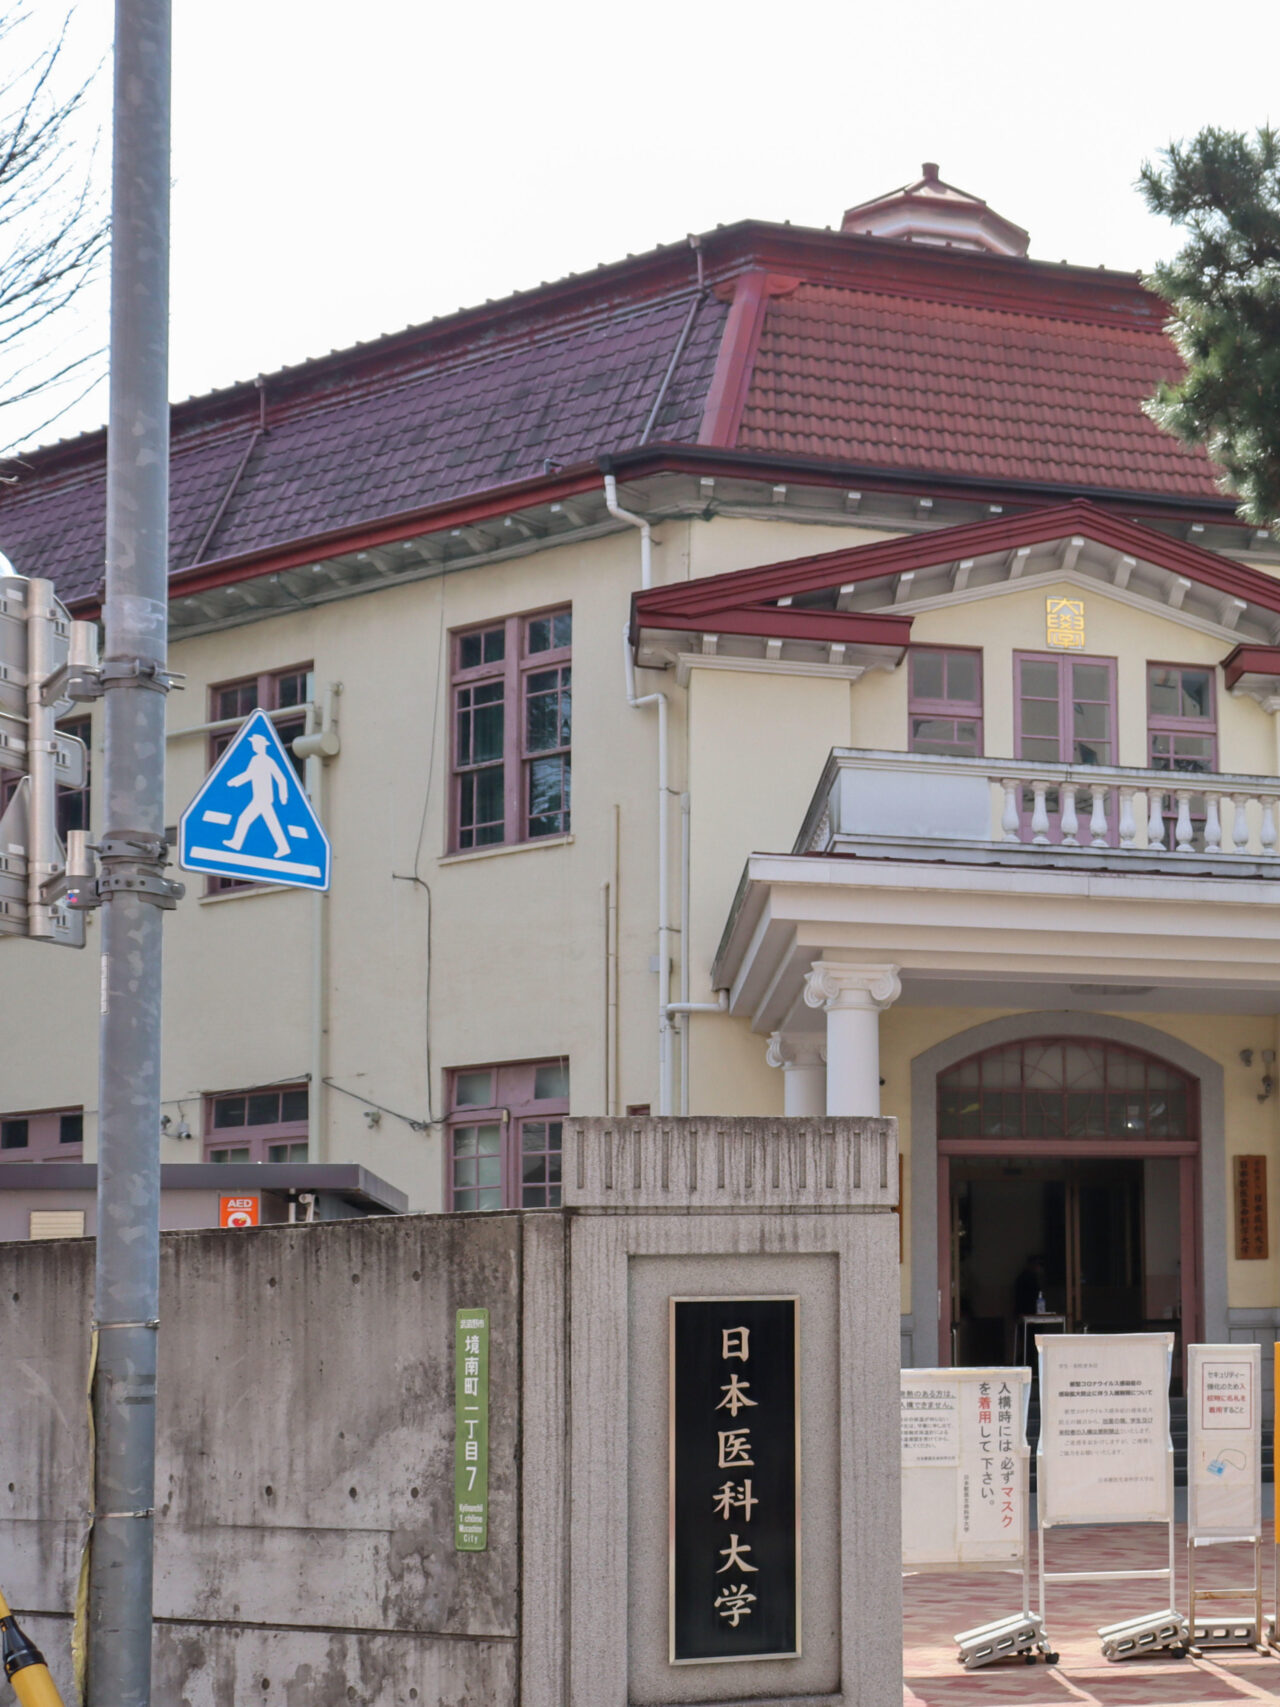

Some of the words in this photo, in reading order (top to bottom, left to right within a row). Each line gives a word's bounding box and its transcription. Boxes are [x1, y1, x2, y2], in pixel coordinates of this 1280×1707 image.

[228, 1199, 252, 1208] AED
[1208, 1371, 1245, 1379] セキュリティー
[1209, 1406, 1245, 1414] 着用すること
[978, 1382, 995, 1506] を着用して下さい。
[997, 1382, 1015, 1529] 入構時には必ずマスク
[712, 1325, 760, 1628] 日本医科大学
[463, 1534, 478, 1544] City
